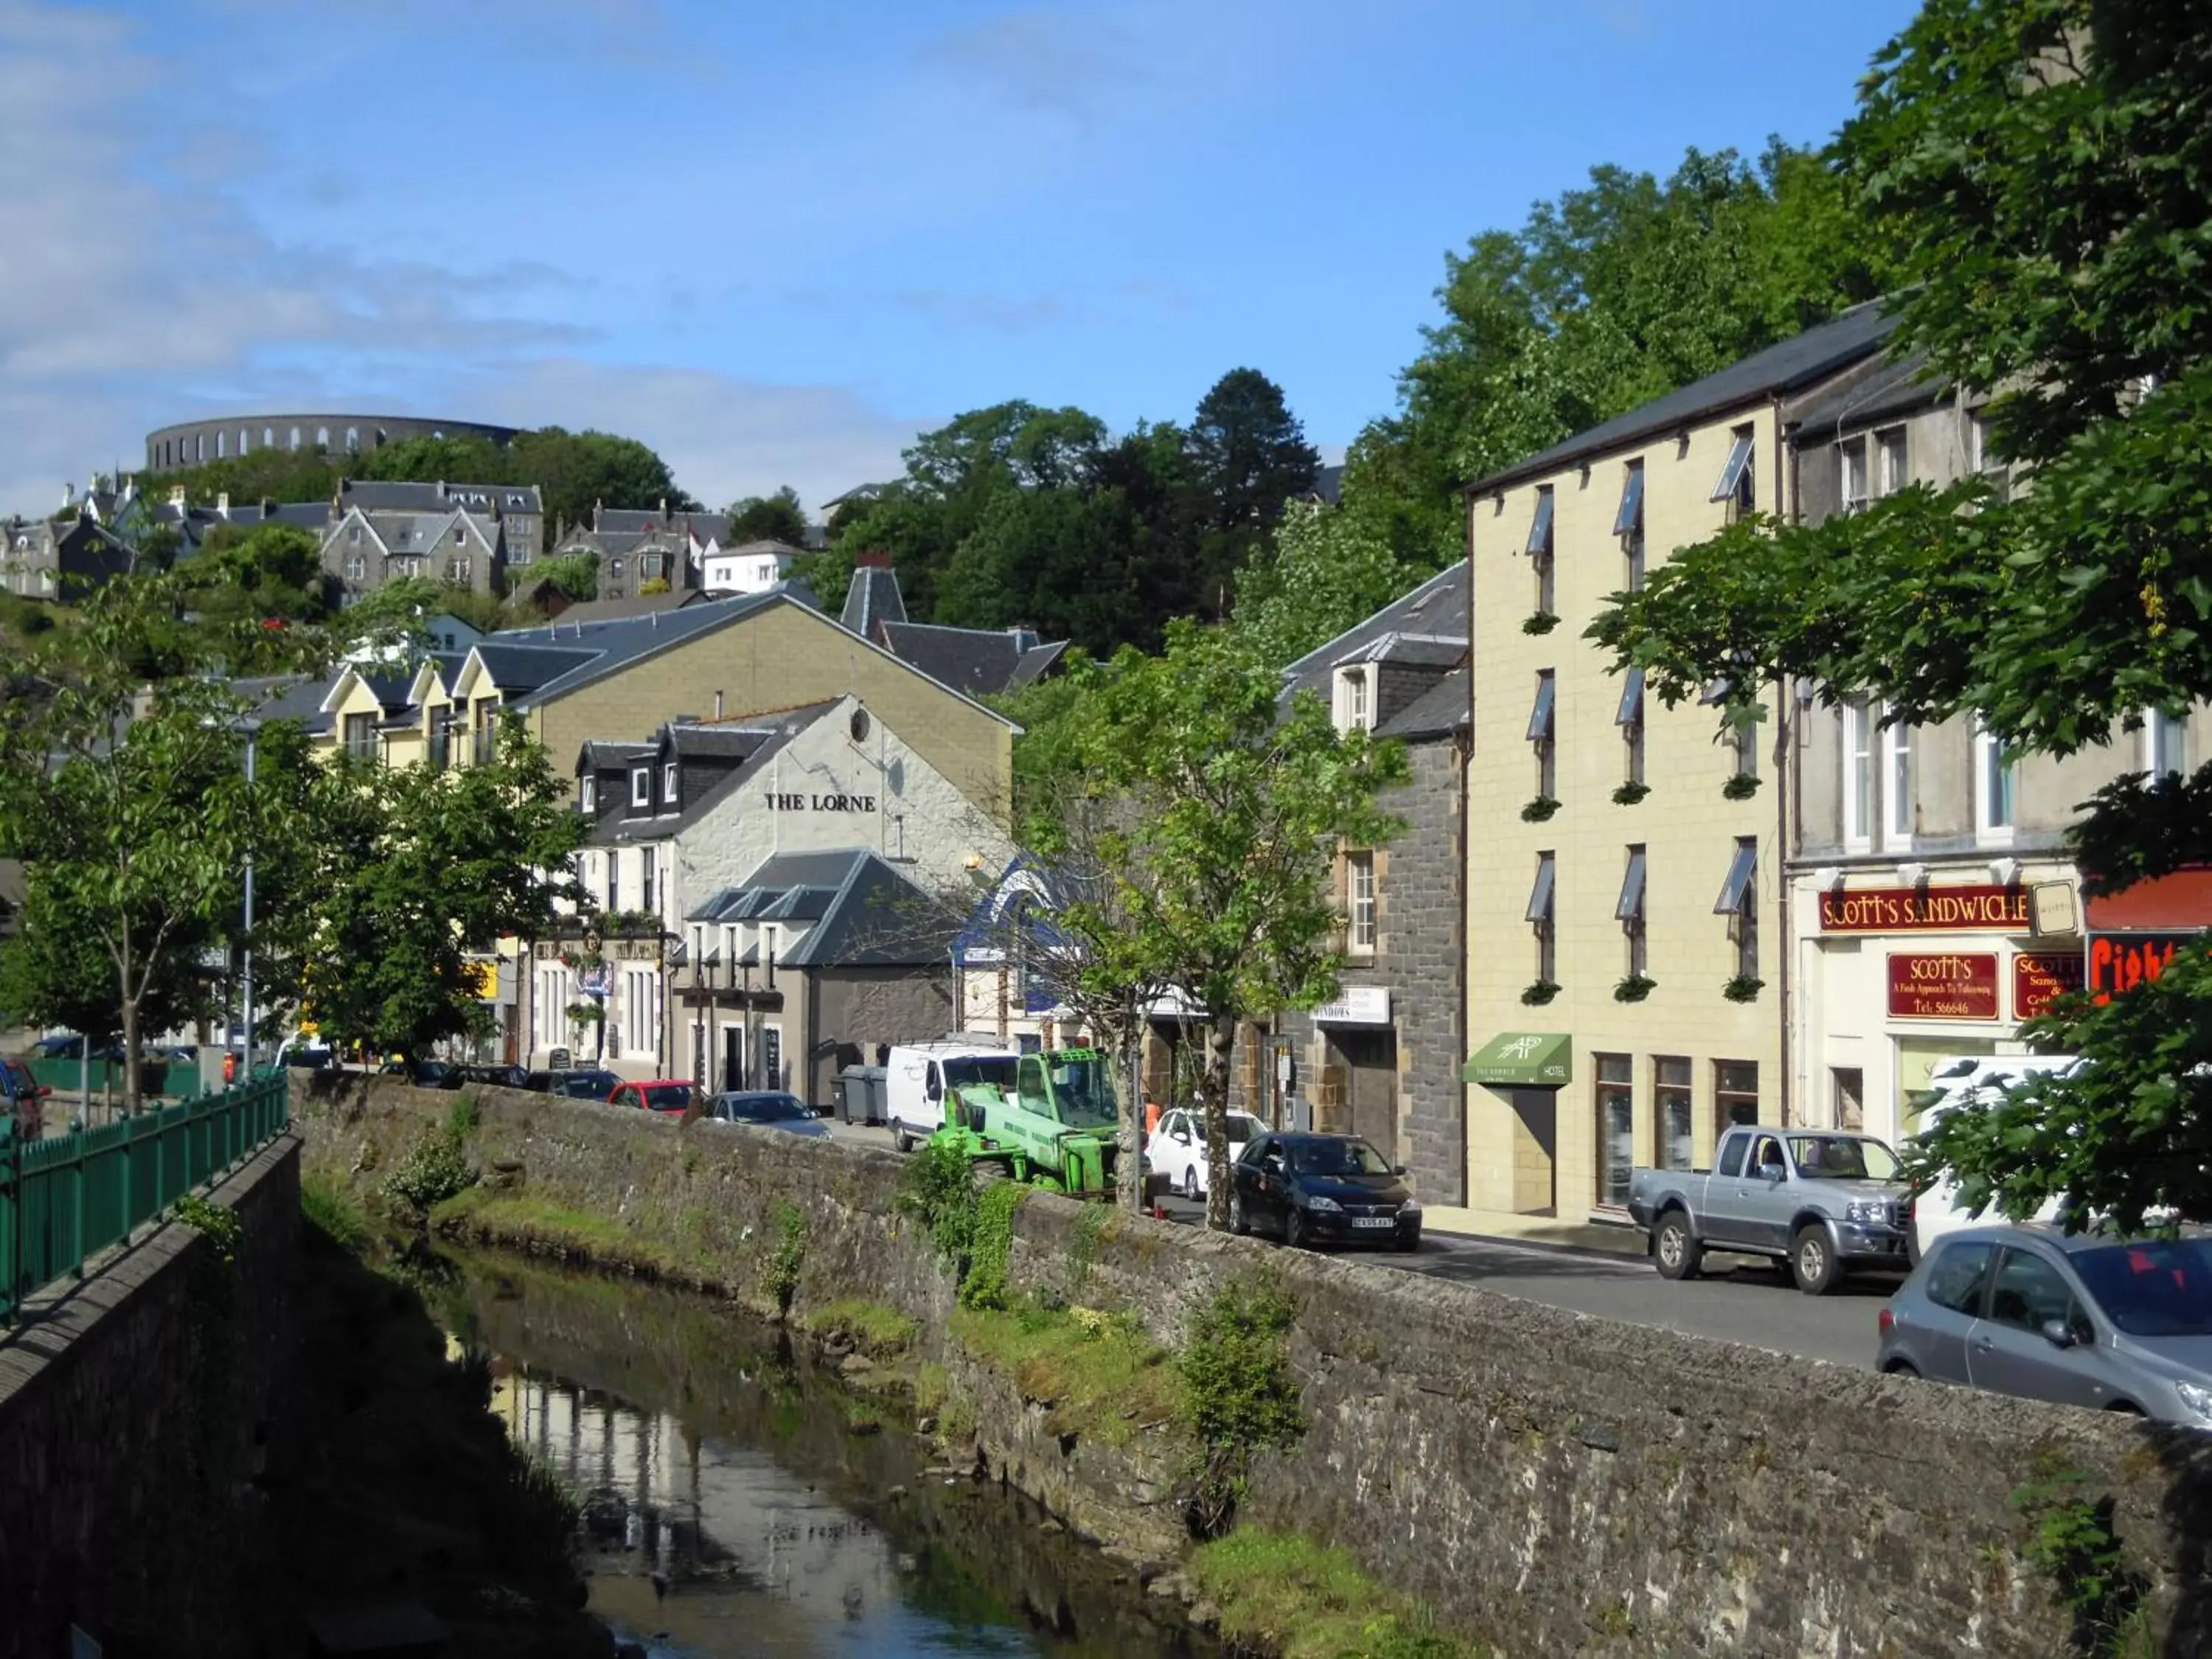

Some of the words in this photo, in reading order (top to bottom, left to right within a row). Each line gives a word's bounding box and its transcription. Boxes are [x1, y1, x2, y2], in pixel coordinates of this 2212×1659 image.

[765, 793, 804, 810] THE
[812, 794, 876, 812] LORNE
[1824, 895, 1899, 925] SCOTT'S
[1910, 956, 1972, 979] SCOTT'S
[1544, 1062, 1566, 1077] HOTEL
